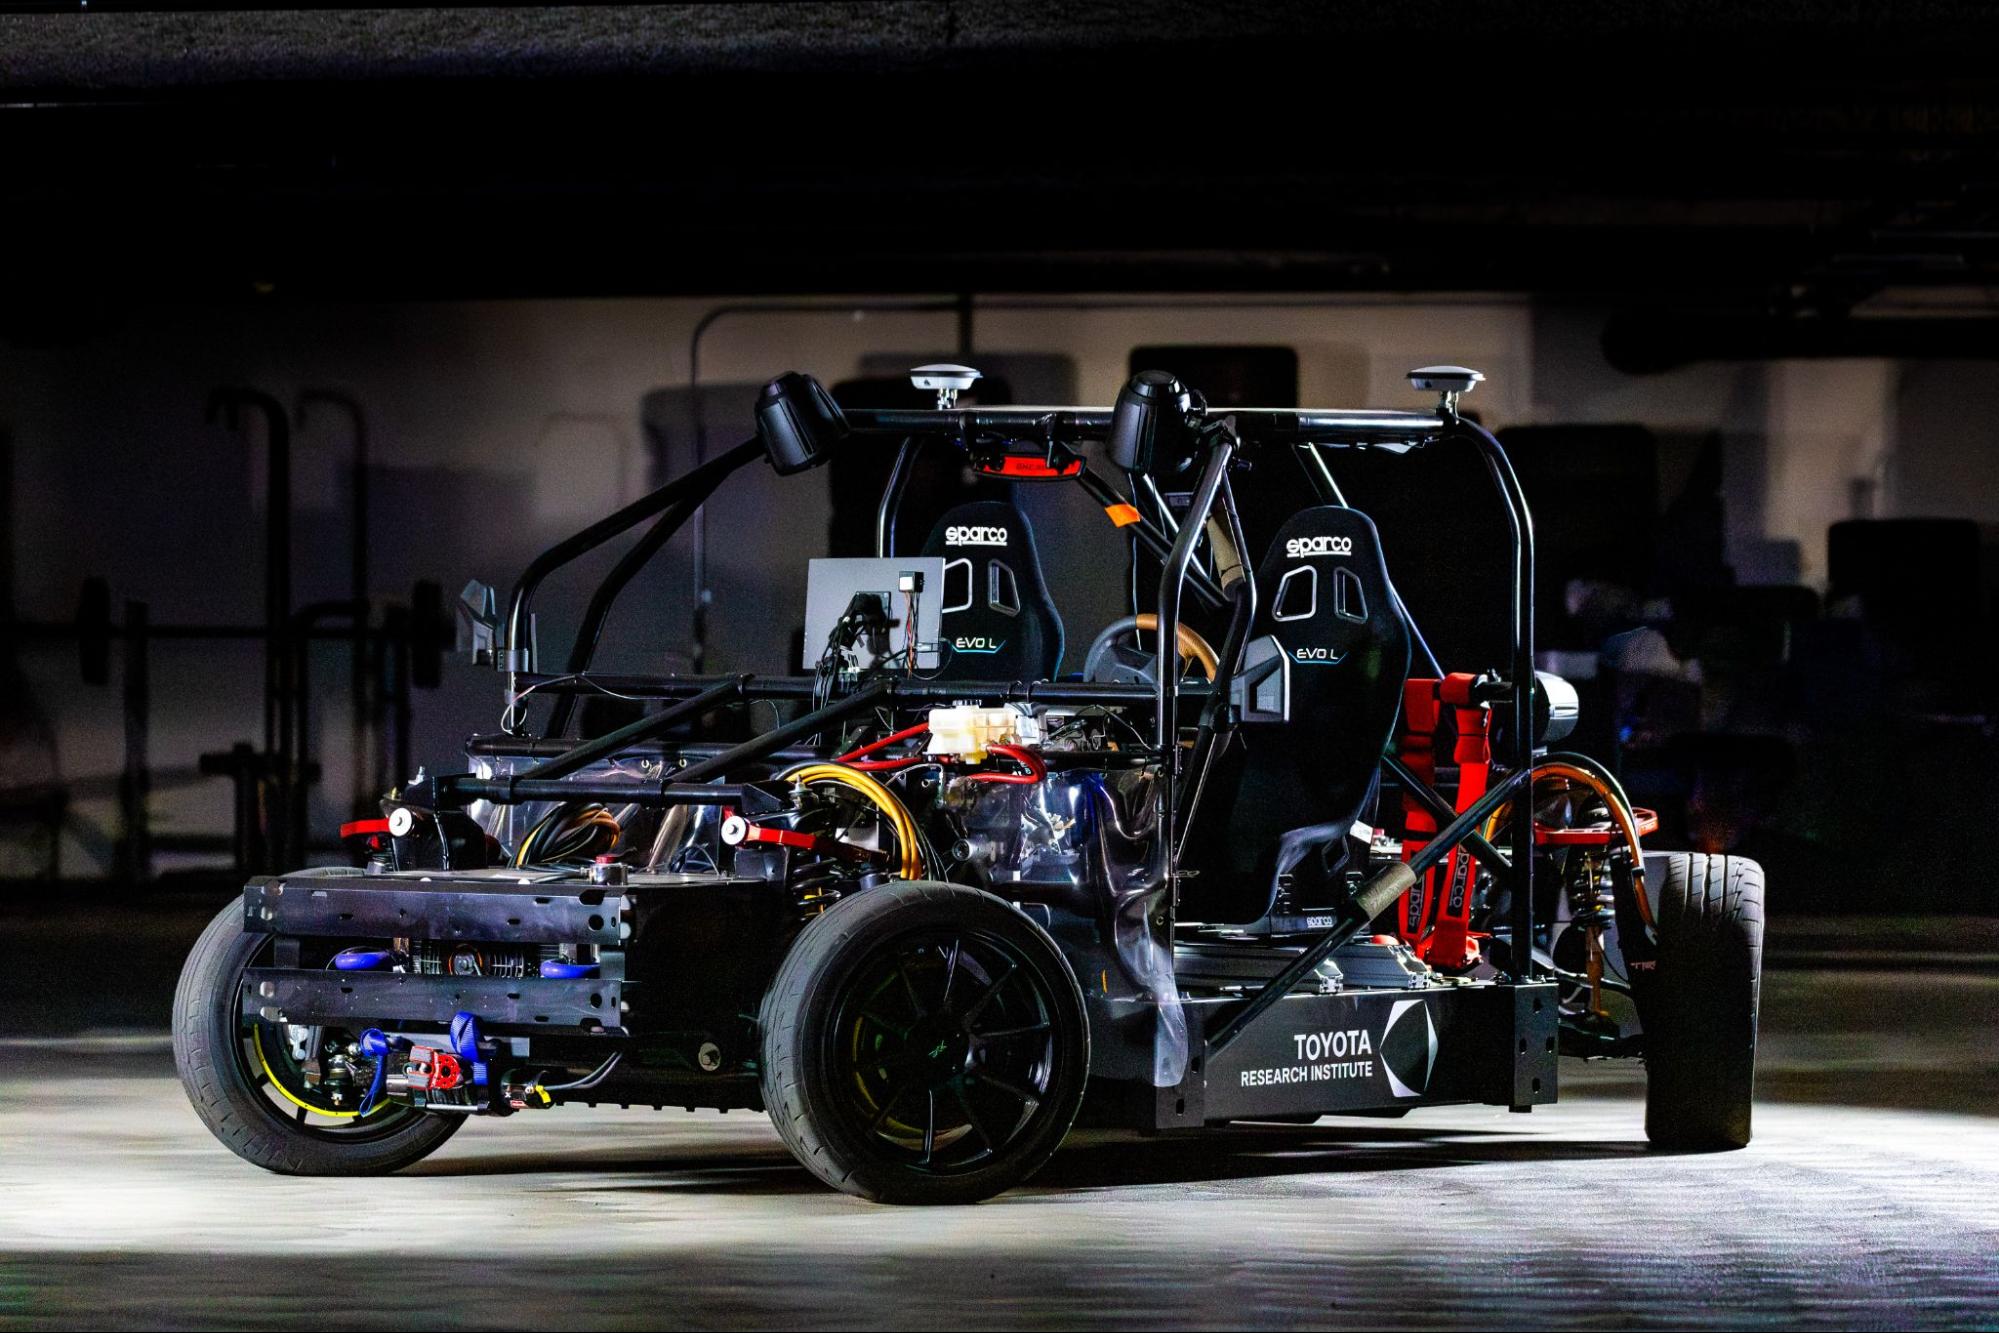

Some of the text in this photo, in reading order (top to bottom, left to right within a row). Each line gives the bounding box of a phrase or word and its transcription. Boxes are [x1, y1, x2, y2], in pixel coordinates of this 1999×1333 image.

[945, 526, 1008, 546] sparco
[1286, 536, 1352, 558] sparco
[956, 637, 997, 649] EVO L
[1296, 647, 1340, 660] EVO L
[1294, 1029, 1372, 1060] TOYOTA
[1241, 1061, 1373, 1087] RESEARCH INSTITUTE
